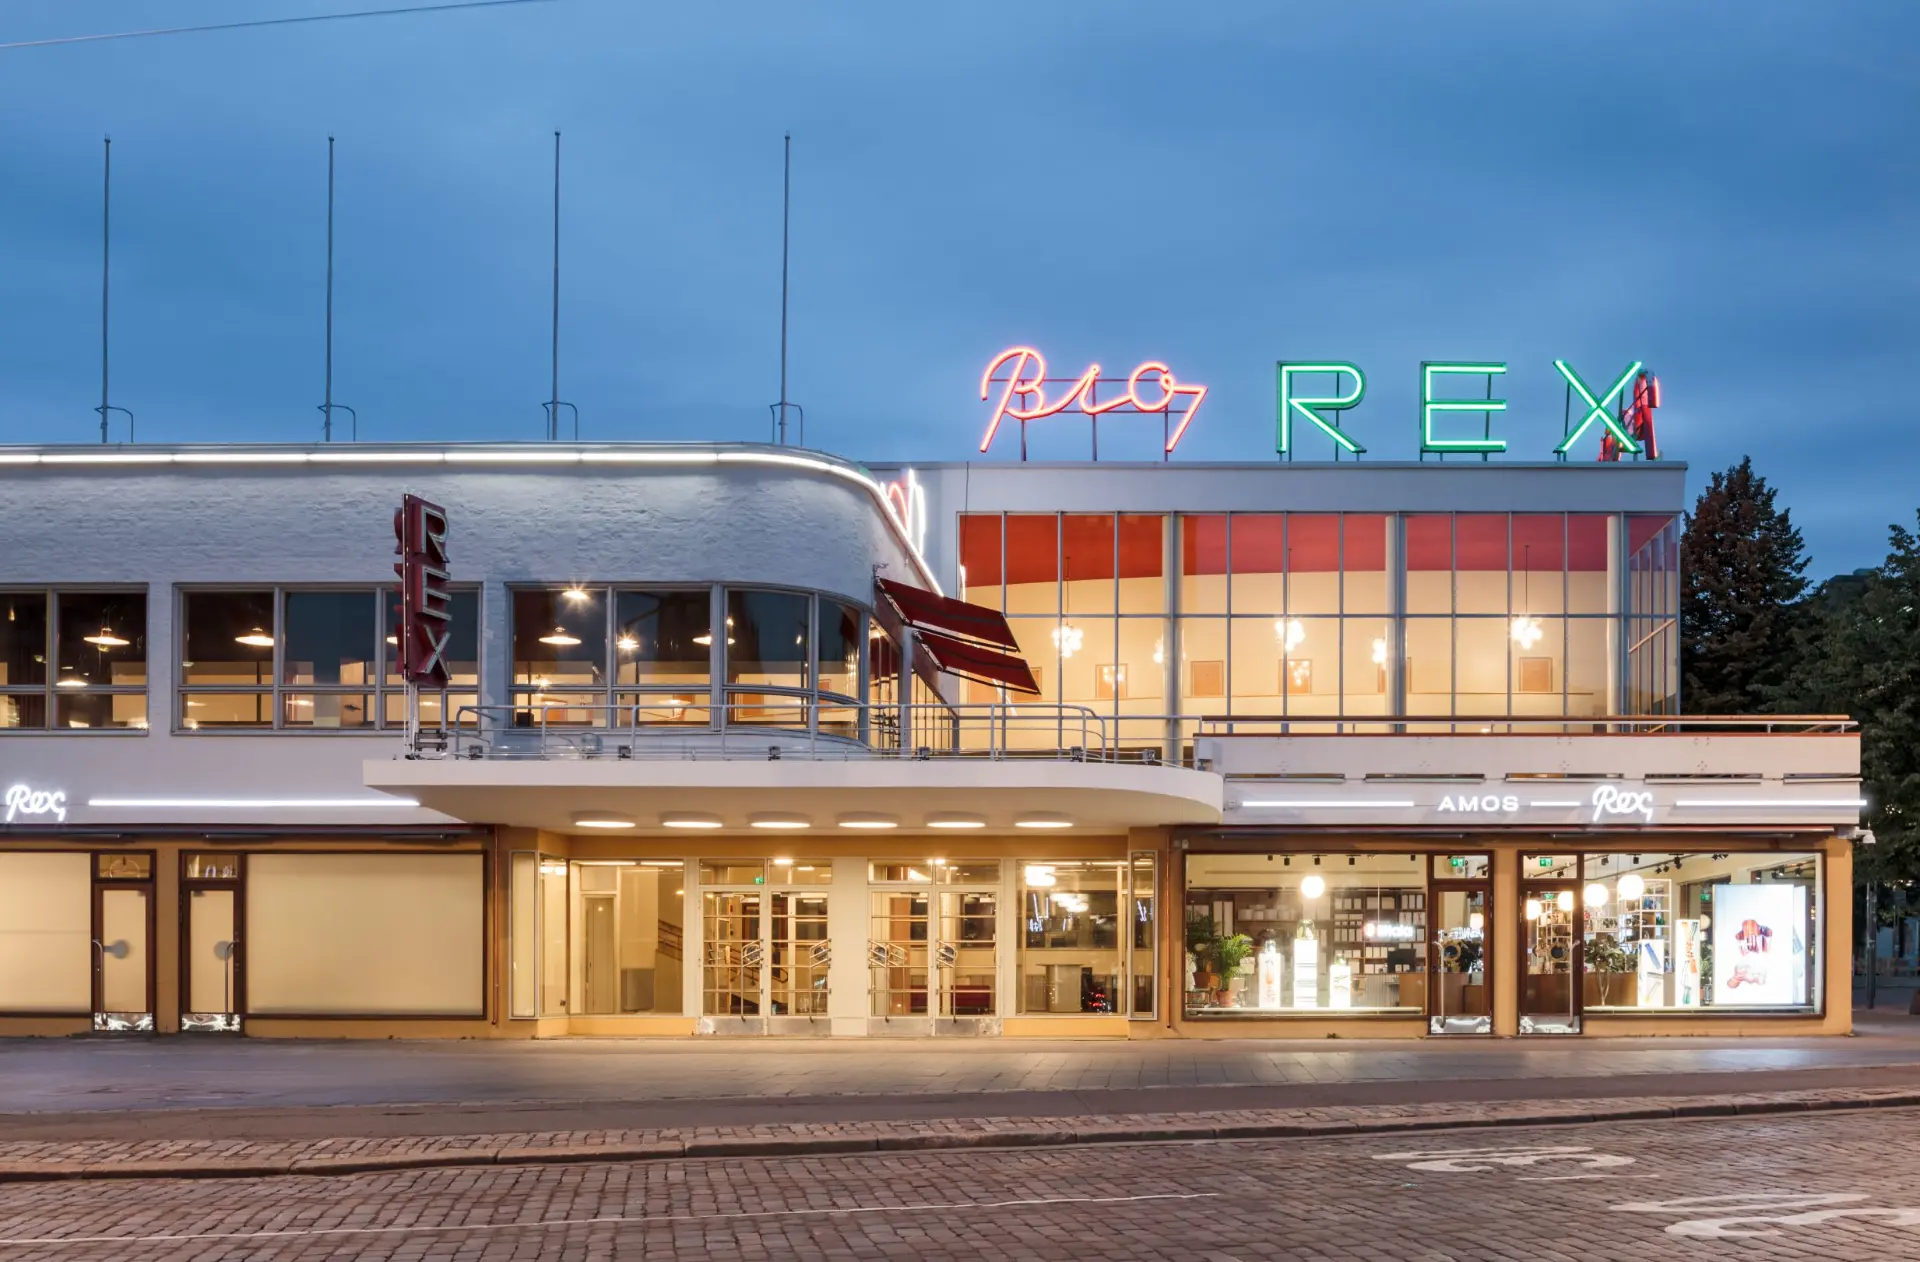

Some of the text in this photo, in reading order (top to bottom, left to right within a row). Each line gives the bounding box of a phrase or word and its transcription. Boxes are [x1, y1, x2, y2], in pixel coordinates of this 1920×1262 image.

[980, 347, 1208, 452] Bio
[1277, 360, 1643, 453] REX
[417, 504, 452, 681] REX
[6, 784, 66, 822] Rex
[1438, 784, 1653, 822] AMOS Rex
